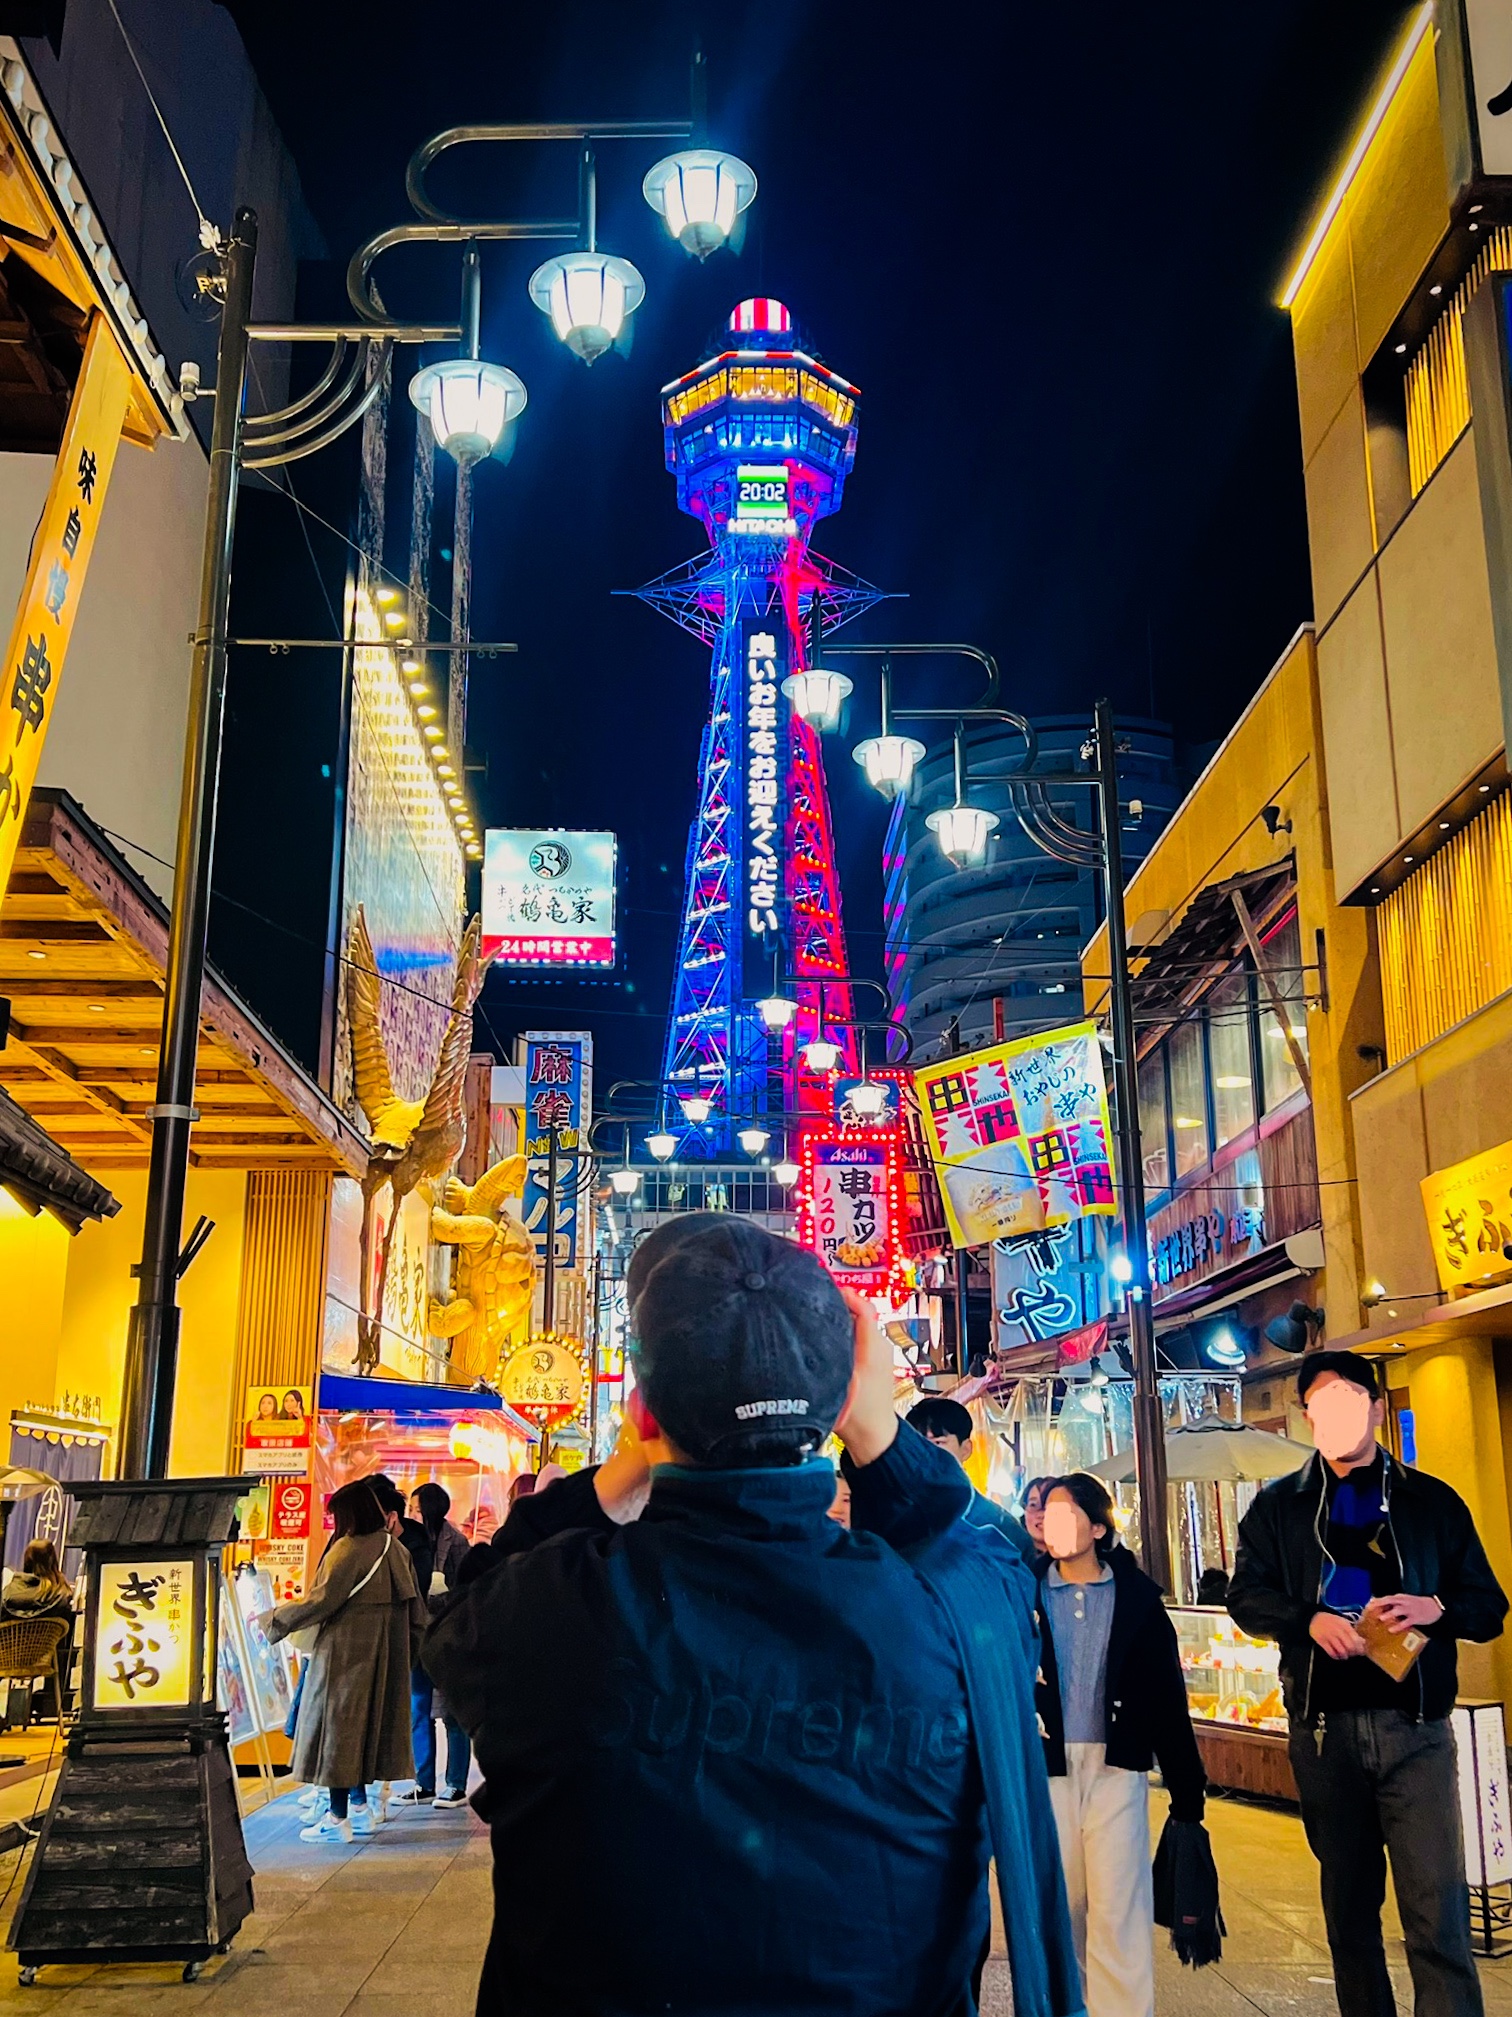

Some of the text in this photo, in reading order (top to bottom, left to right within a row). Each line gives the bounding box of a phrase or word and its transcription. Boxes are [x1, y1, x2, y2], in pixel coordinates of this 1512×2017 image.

[739, 482, 786, 501] 20:02
[728, 517, 798, 534] HITACHI
[747, 631, 779, 933] 良いお年をお迎えください
[519, 895, 598, 924] 鶴亀家
[530, 1044, 574, 1130] 麻雀
[928, 1076, 970, 1113] 串
[526, 1129, 579, 1158] NEW
[830, 1147, 868, 1162] Asahi
[1031, 1134, 1070, 1172] 串
[838, 1167, 876, 1245] 串カツ
[734, 1398, 810, 1420] SUPREME
[168, 1568, 182, 1645] 新世界串かつ
[108, 1571, 166, 1700] ぎふや
